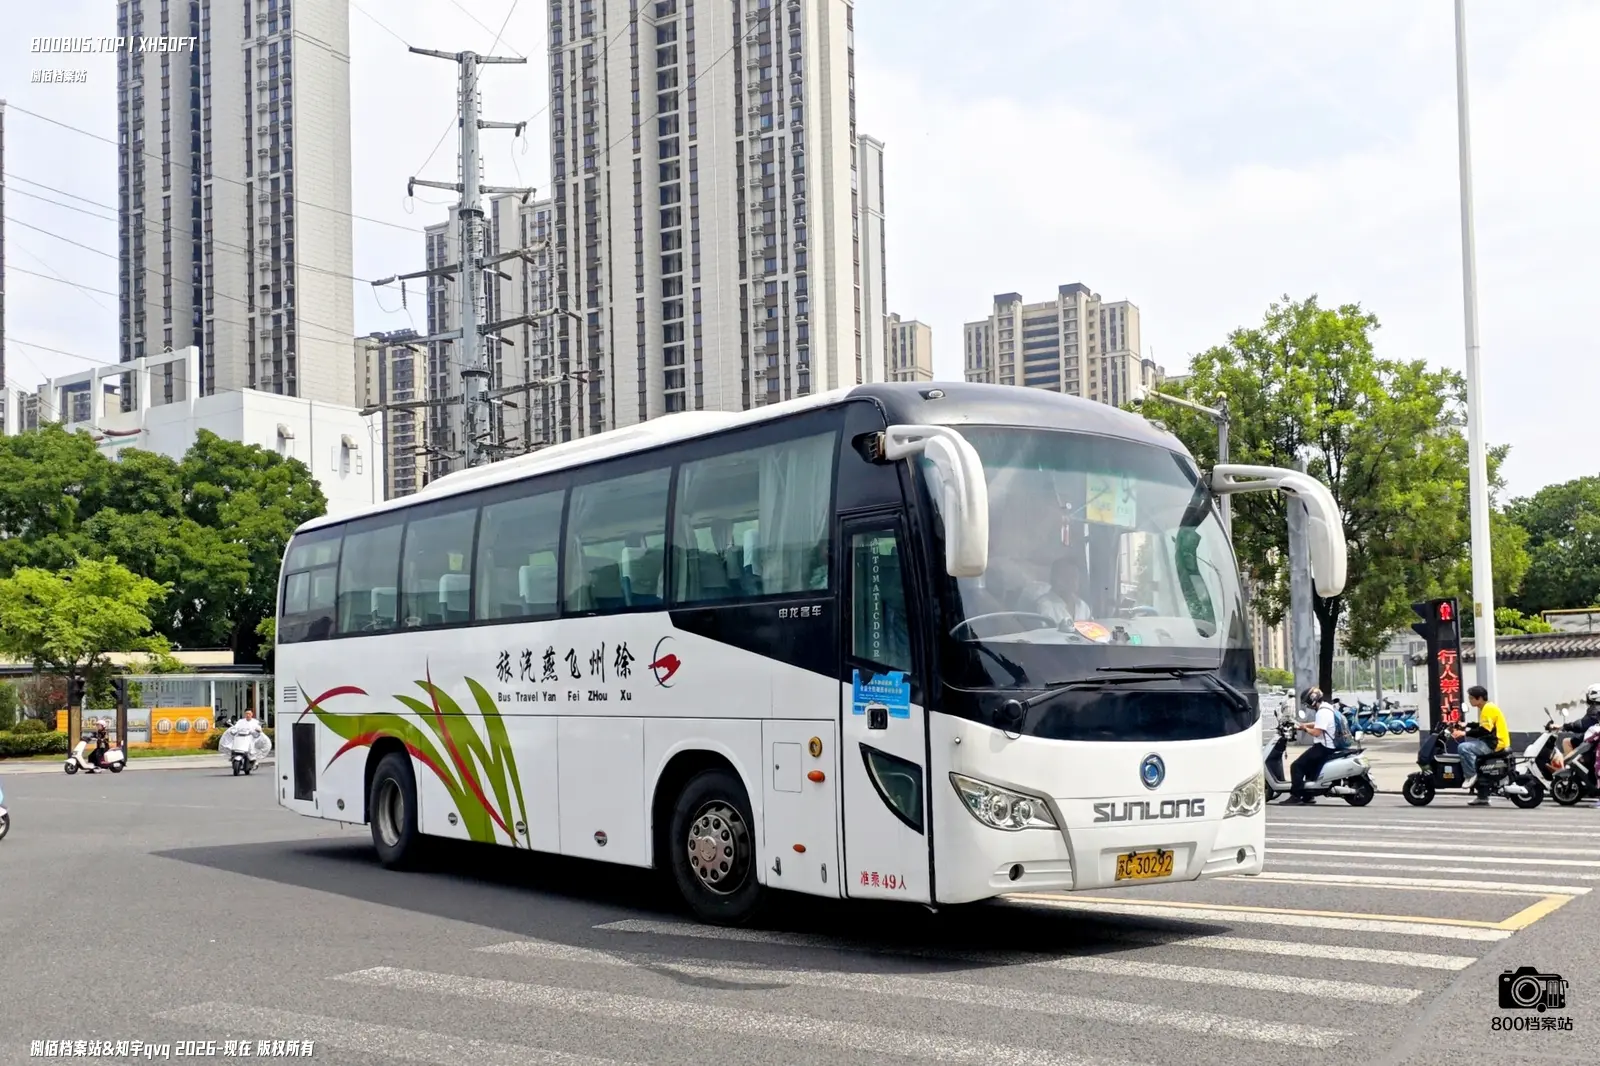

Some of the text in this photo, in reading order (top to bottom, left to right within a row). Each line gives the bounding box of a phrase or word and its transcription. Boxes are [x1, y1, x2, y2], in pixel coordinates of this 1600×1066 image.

[779, 605, 821, 618] 申龙客车
[498, 689, 632, 702] Bus Travel Yan Fei ZHou Xu
[1093, 798, 1205, 823] SUNLONG
[860, 870, 907, 890] 准乘49人
